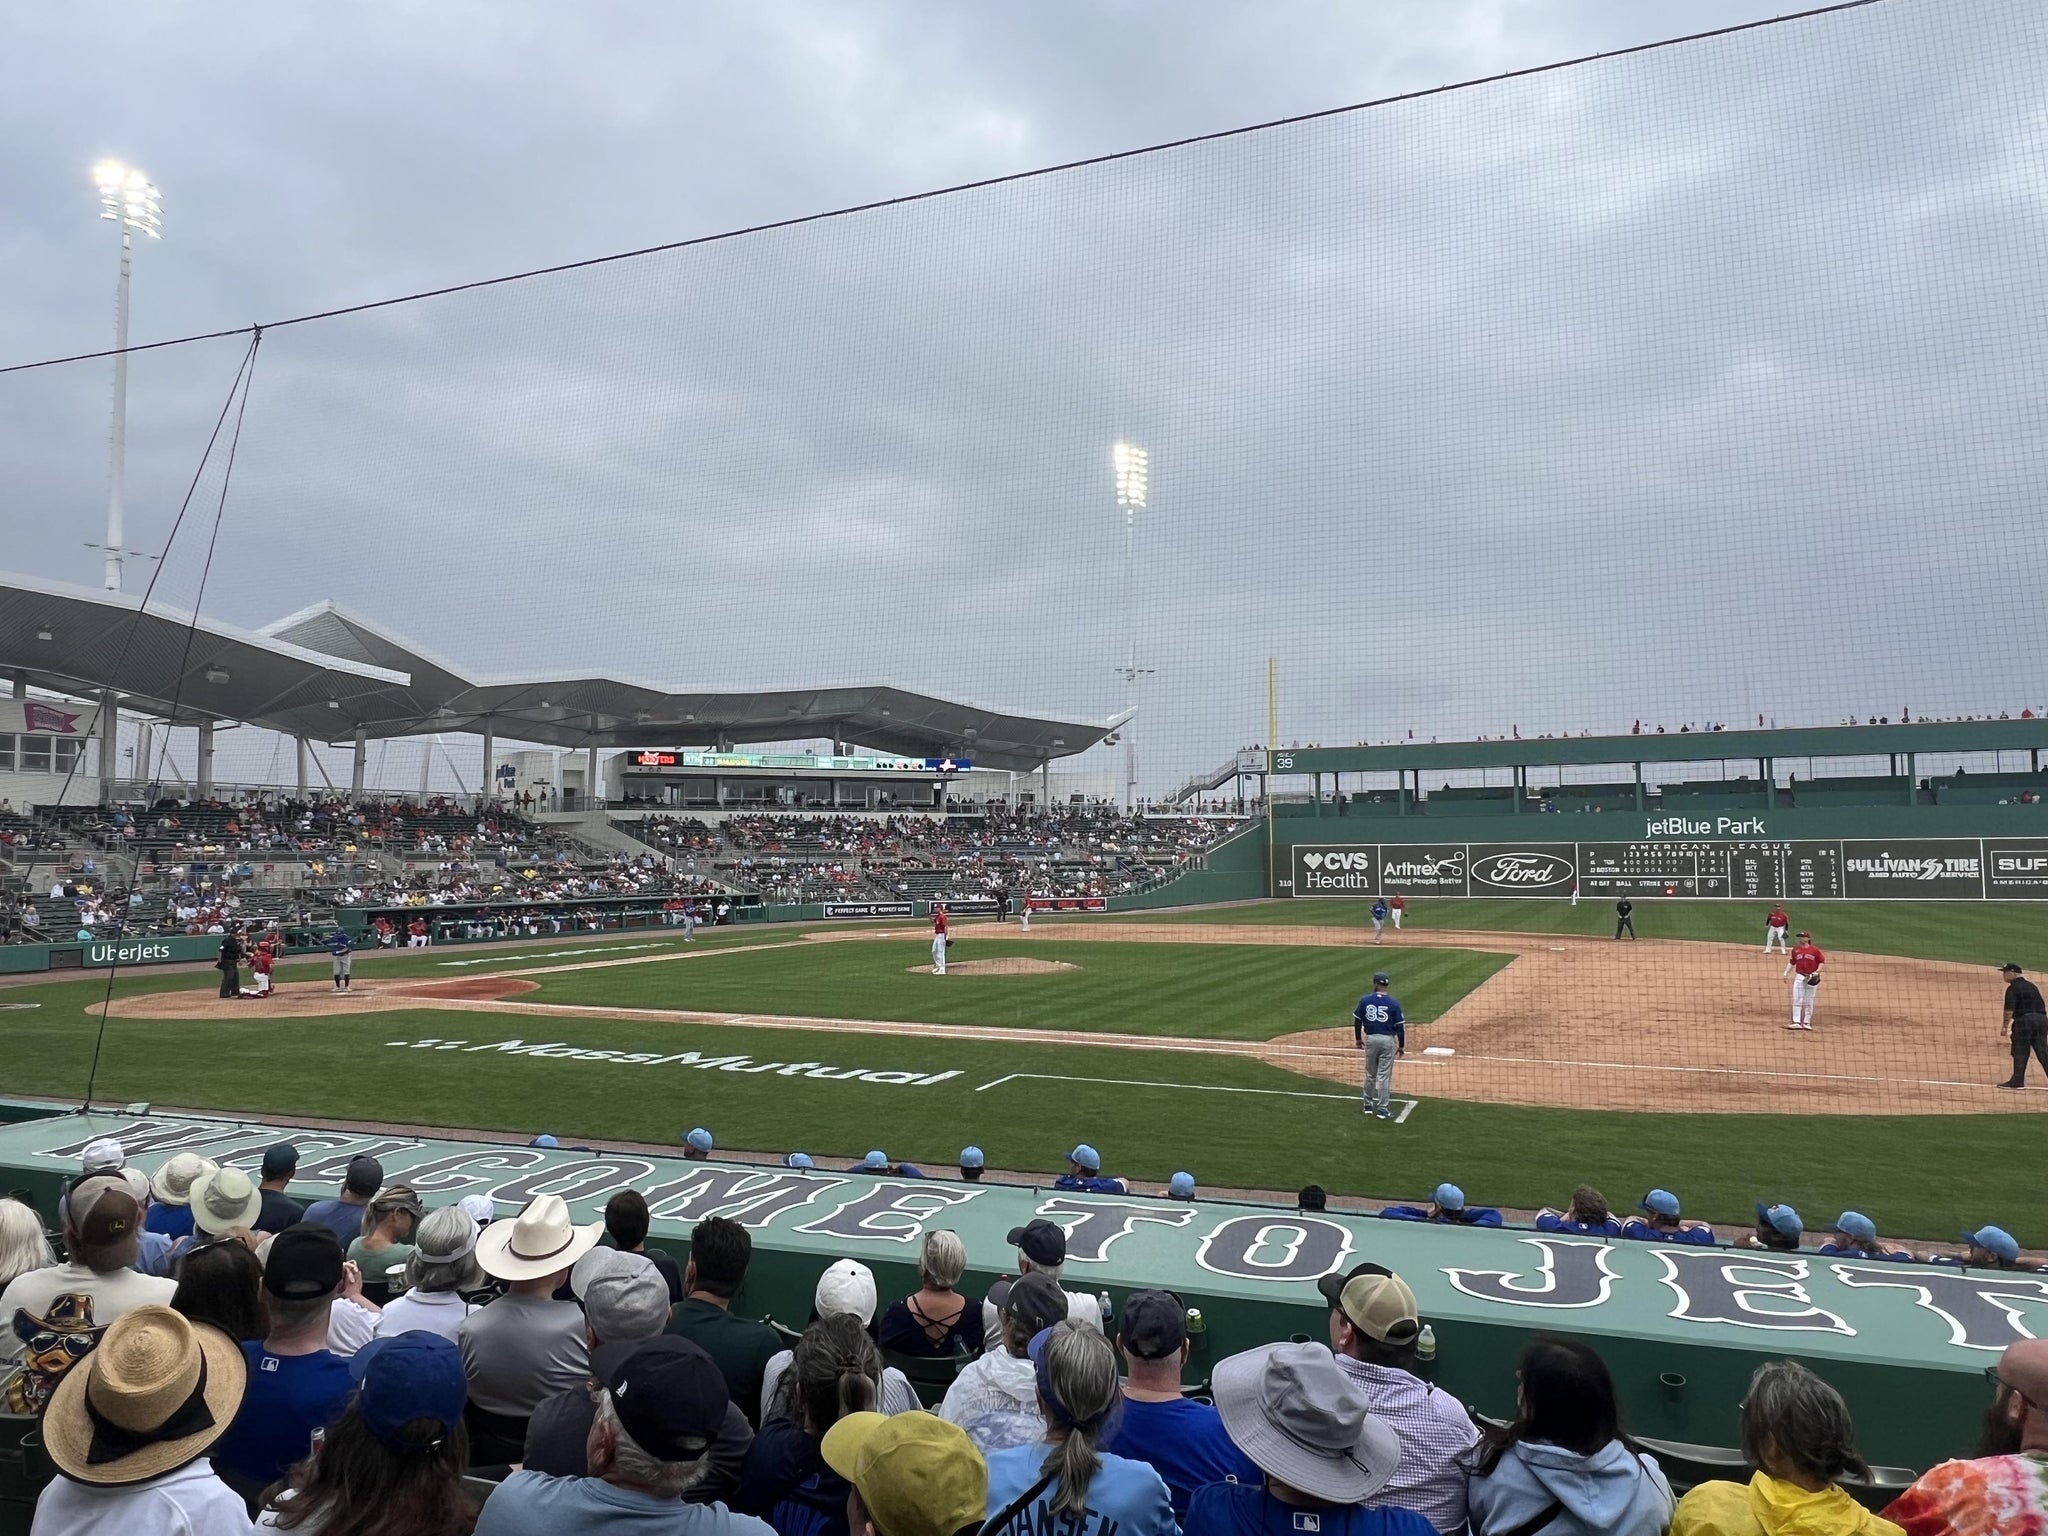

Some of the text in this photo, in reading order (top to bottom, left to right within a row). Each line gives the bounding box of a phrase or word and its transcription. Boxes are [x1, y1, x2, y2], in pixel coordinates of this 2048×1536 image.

[1277, 758, 1293, 769] 39
[1645, 816, 1766, 839] jetBlue Park
[1322, 852, 1369, 870] CVS
[1383, 861, 1442, 876] Arthrex
[1490, 857, 1554, 883] Ford
[1846, 858, 1979, 872] SULLIVAN TIRE
[1306, 872, 1369, 888] Health
[91, 943, 170, 962] UberJets
[1365, 1004, 1389, 1023] 85
[464, 1039, 965, 1086] MassMutual
[32, 1121, 2048, 1351] WELCOME TO JET
